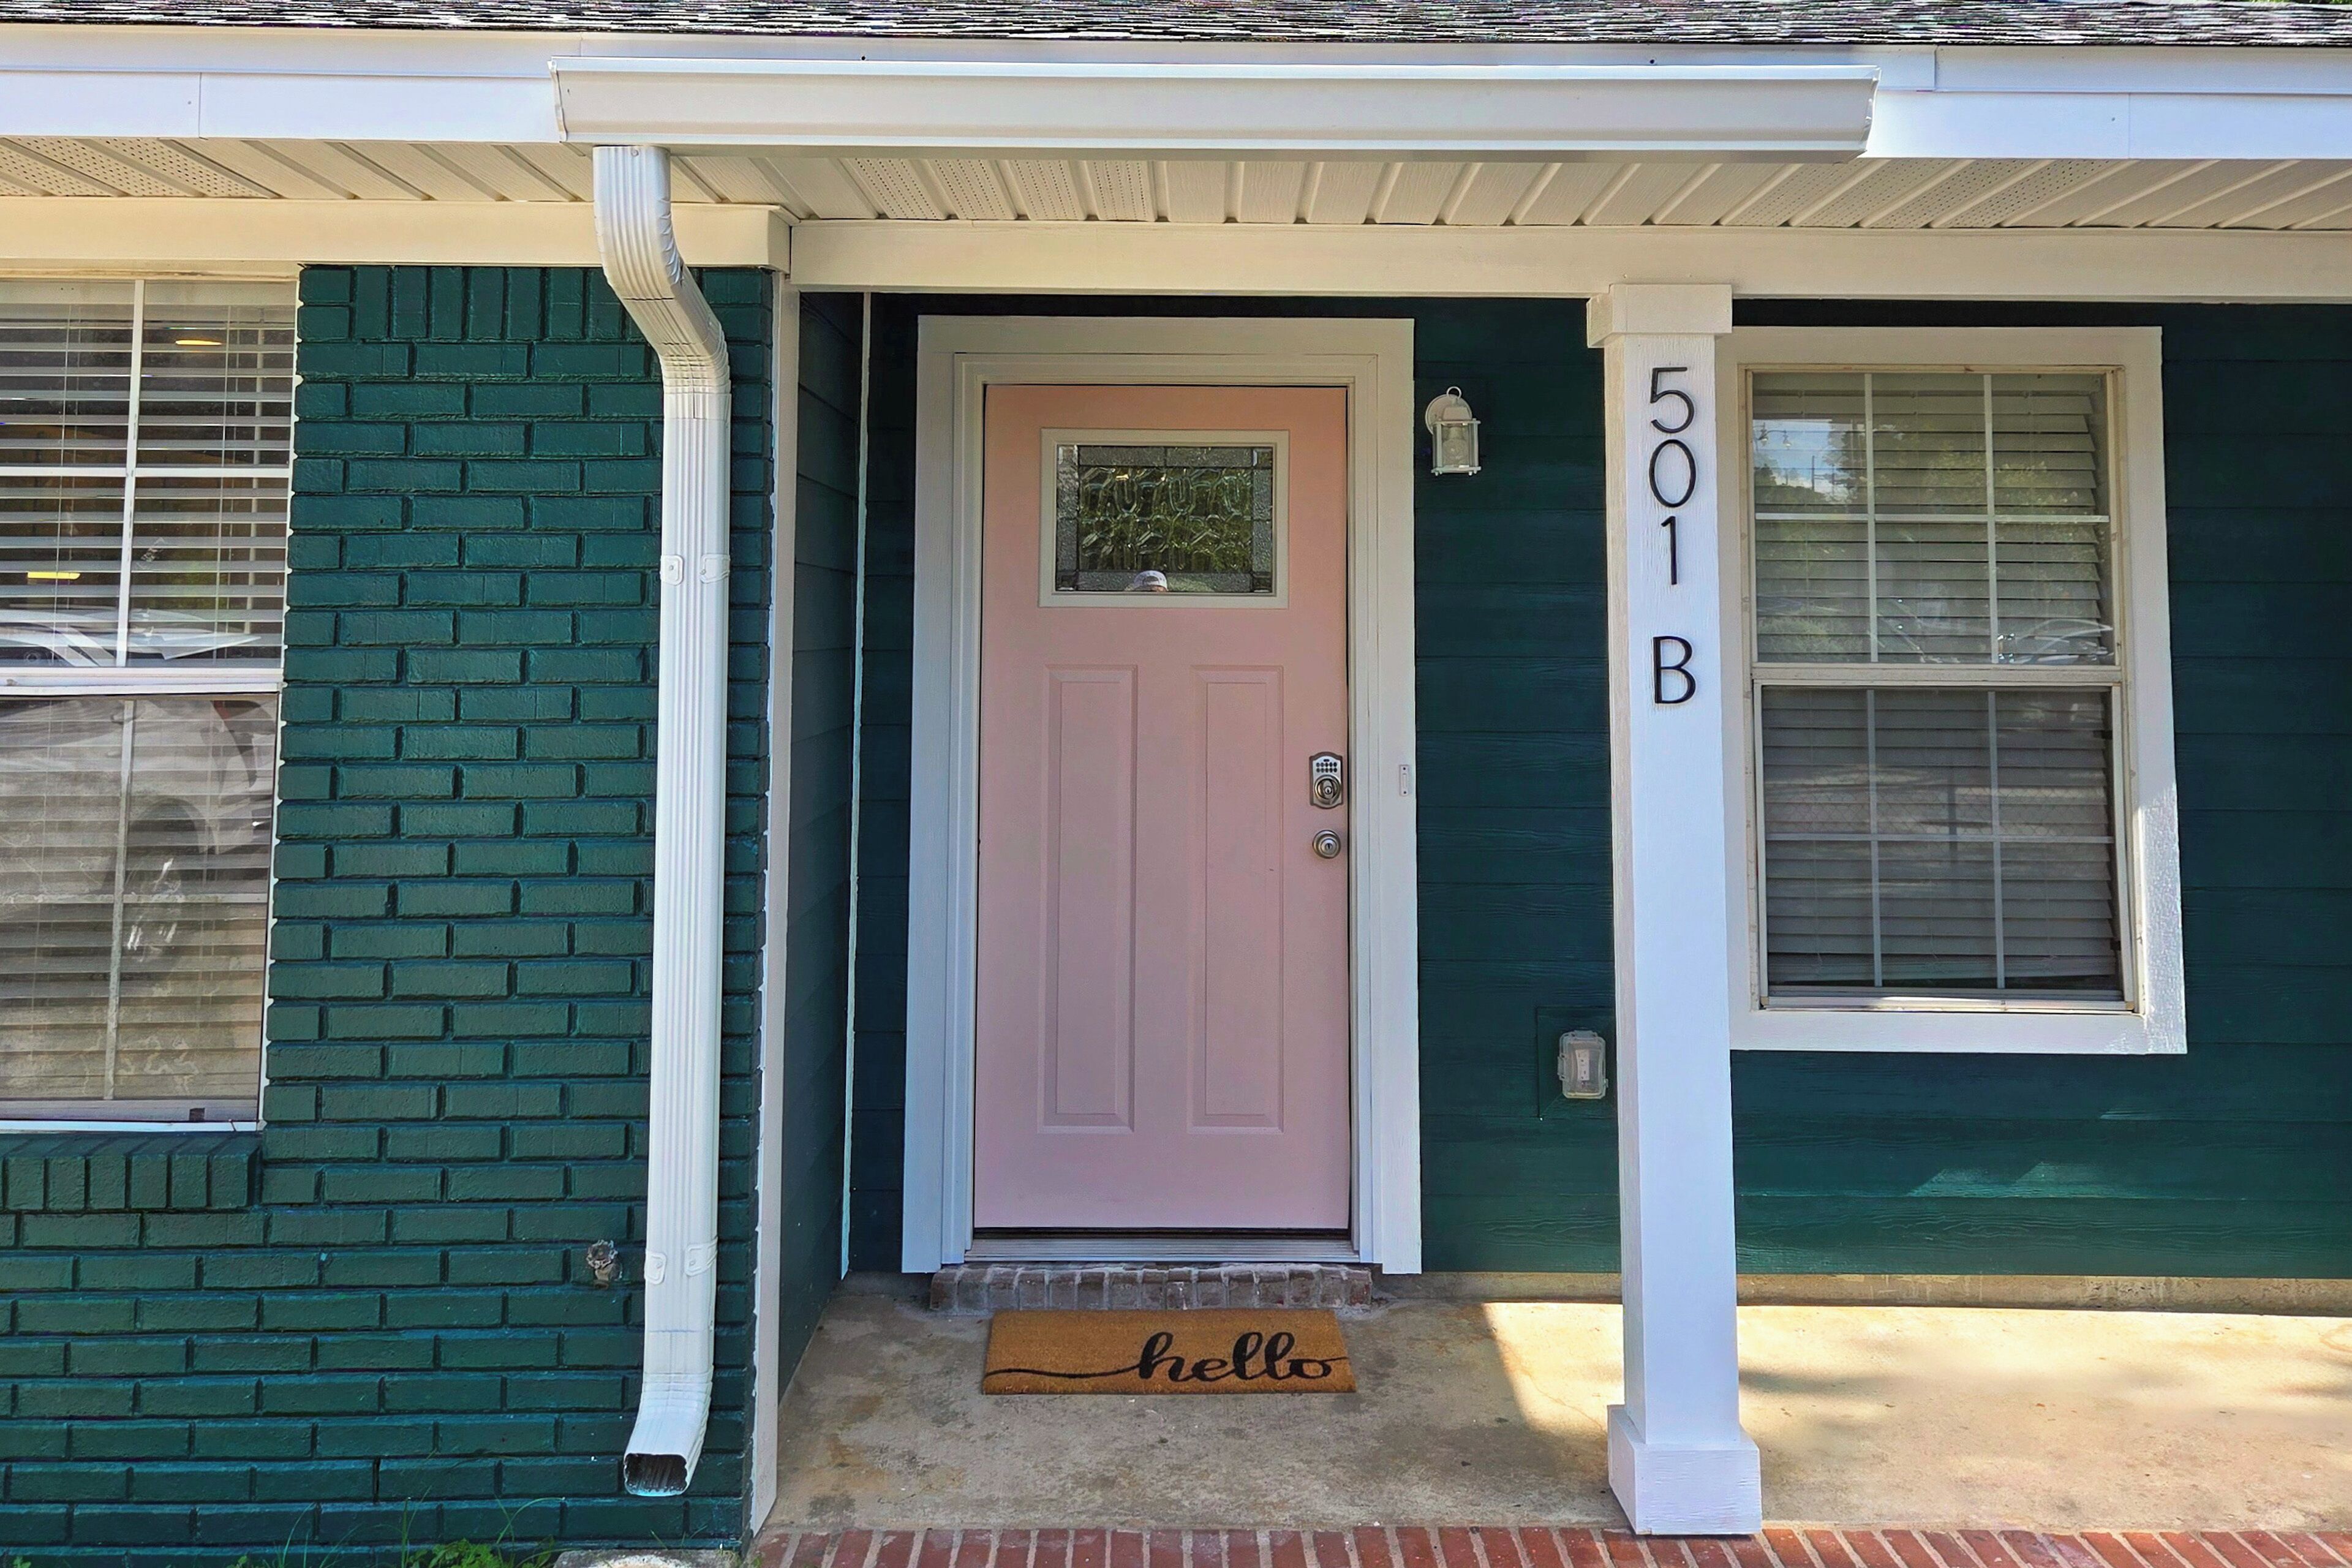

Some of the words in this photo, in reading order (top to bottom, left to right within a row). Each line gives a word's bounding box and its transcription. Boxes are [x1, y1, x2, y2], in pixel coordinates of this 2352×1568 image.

[1649, 367, 1697, 586] 501
[1653, 636, 1696, 704] B
[1134, 1332, 1347, 1382] hello
